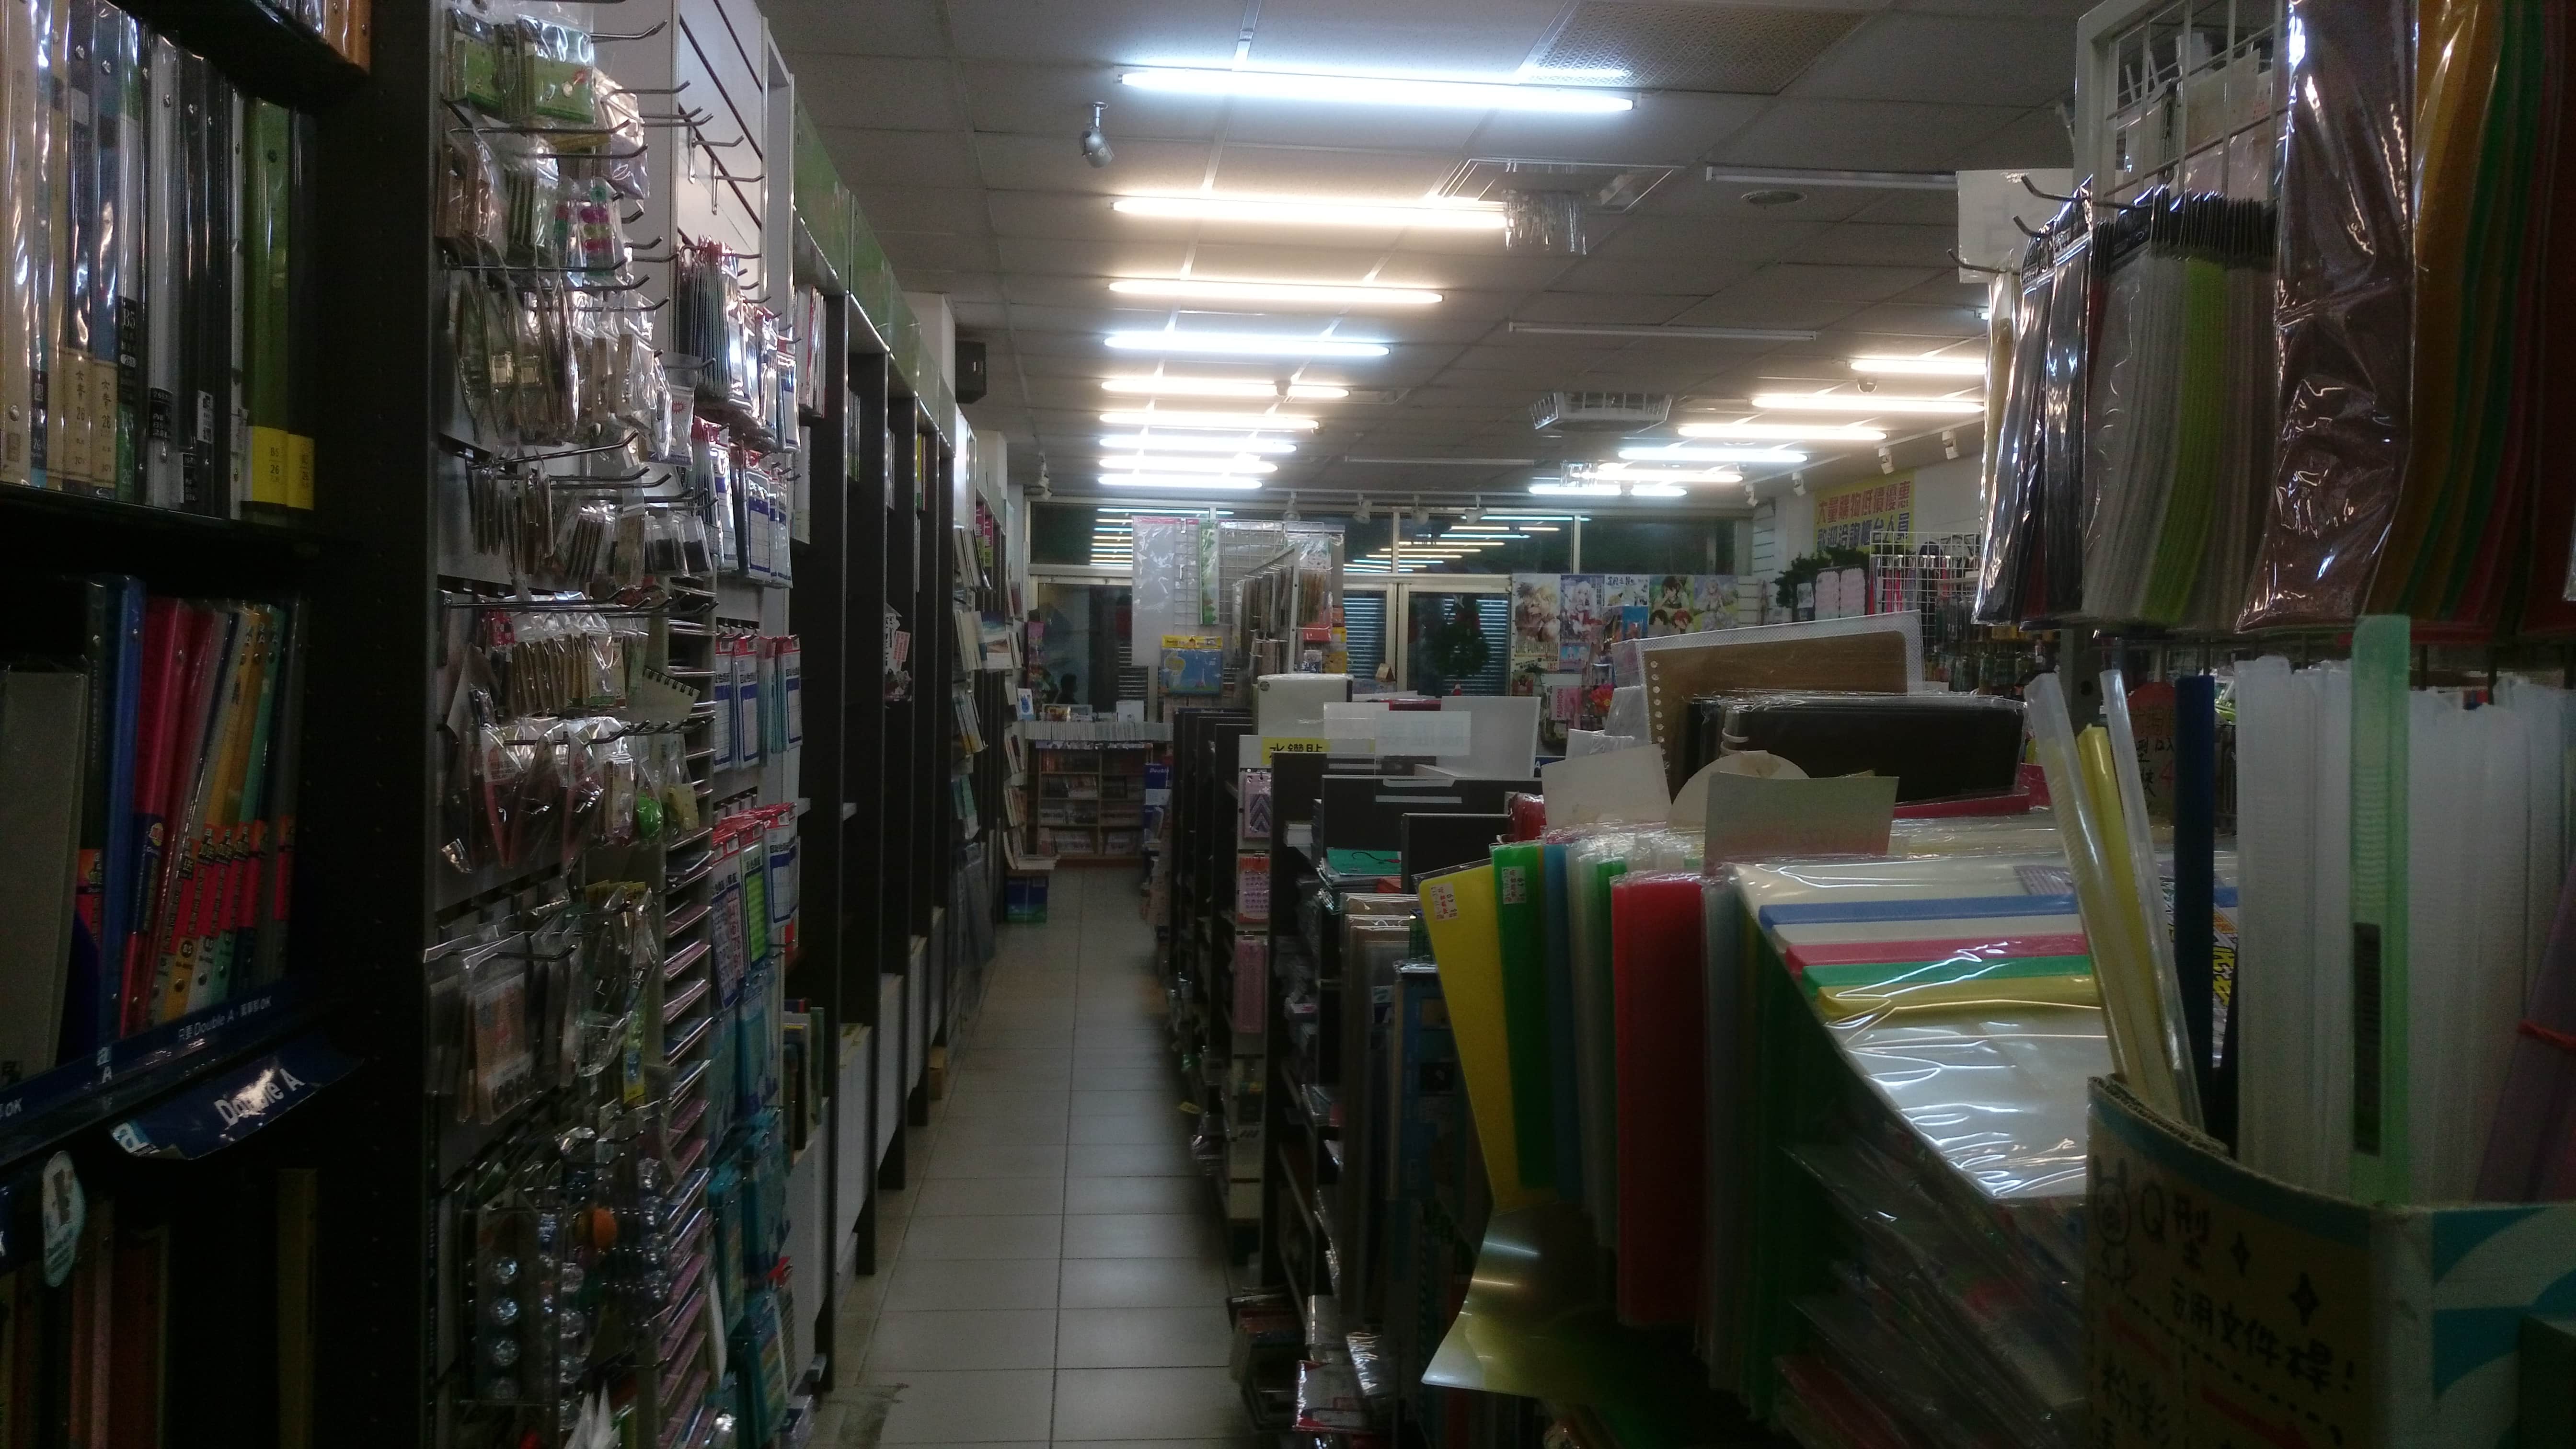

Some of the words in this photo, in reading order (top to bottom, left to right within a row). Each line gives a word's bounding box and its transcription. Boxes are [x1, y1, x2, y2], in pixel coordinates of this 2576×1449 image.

[122, 308, 136, 330] B5
[270, 447, 279, 457] B5
[270, 465, 279, 474] 26
[1817, 480, 1911, 525] 大量購物低價優惠
[279, 1068, 306, 1092] A
